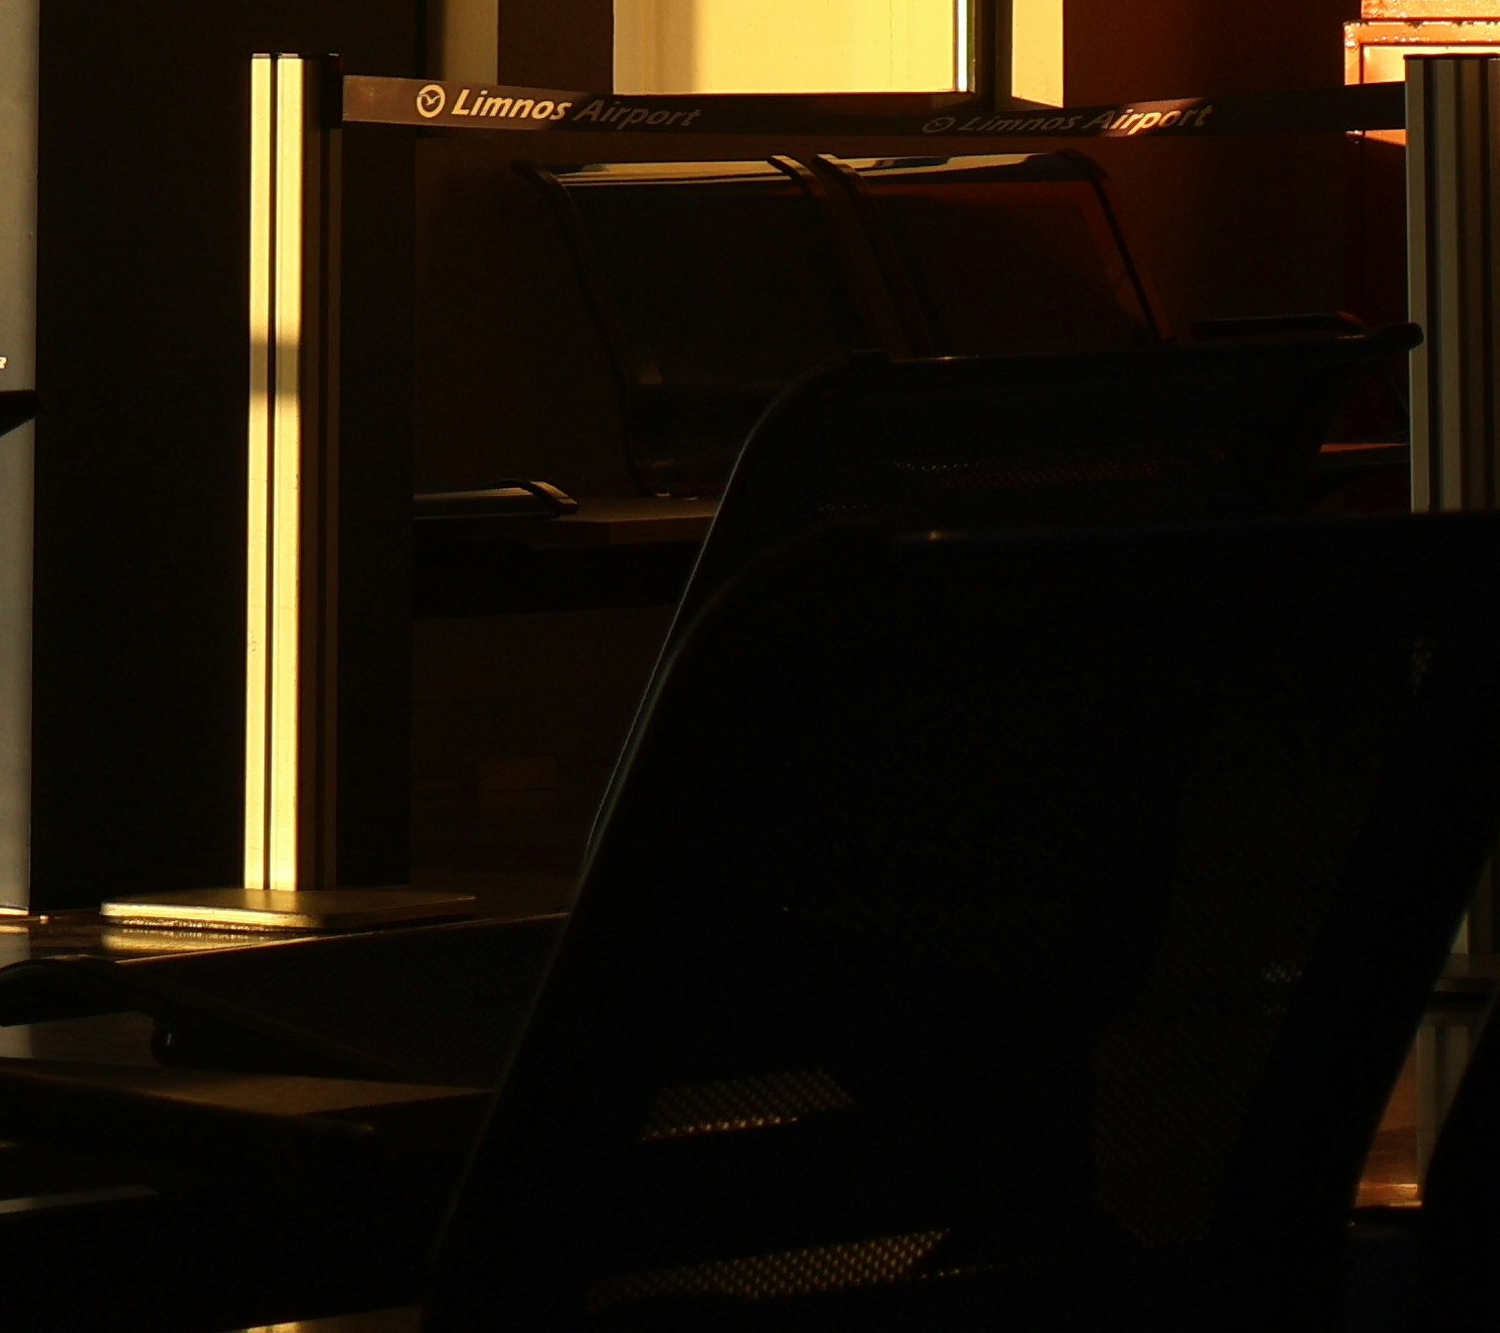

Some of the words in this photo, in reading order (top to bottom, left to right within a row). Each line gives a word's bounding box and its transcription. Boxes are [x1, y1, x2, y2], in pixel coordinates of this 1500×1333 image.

[451, 88, 574, 121] Limnos
[572, 99, 703, 131] Airport
[957, 114, 1084, 133] Limnos
[1082, 104, 1214, 136] Airport
